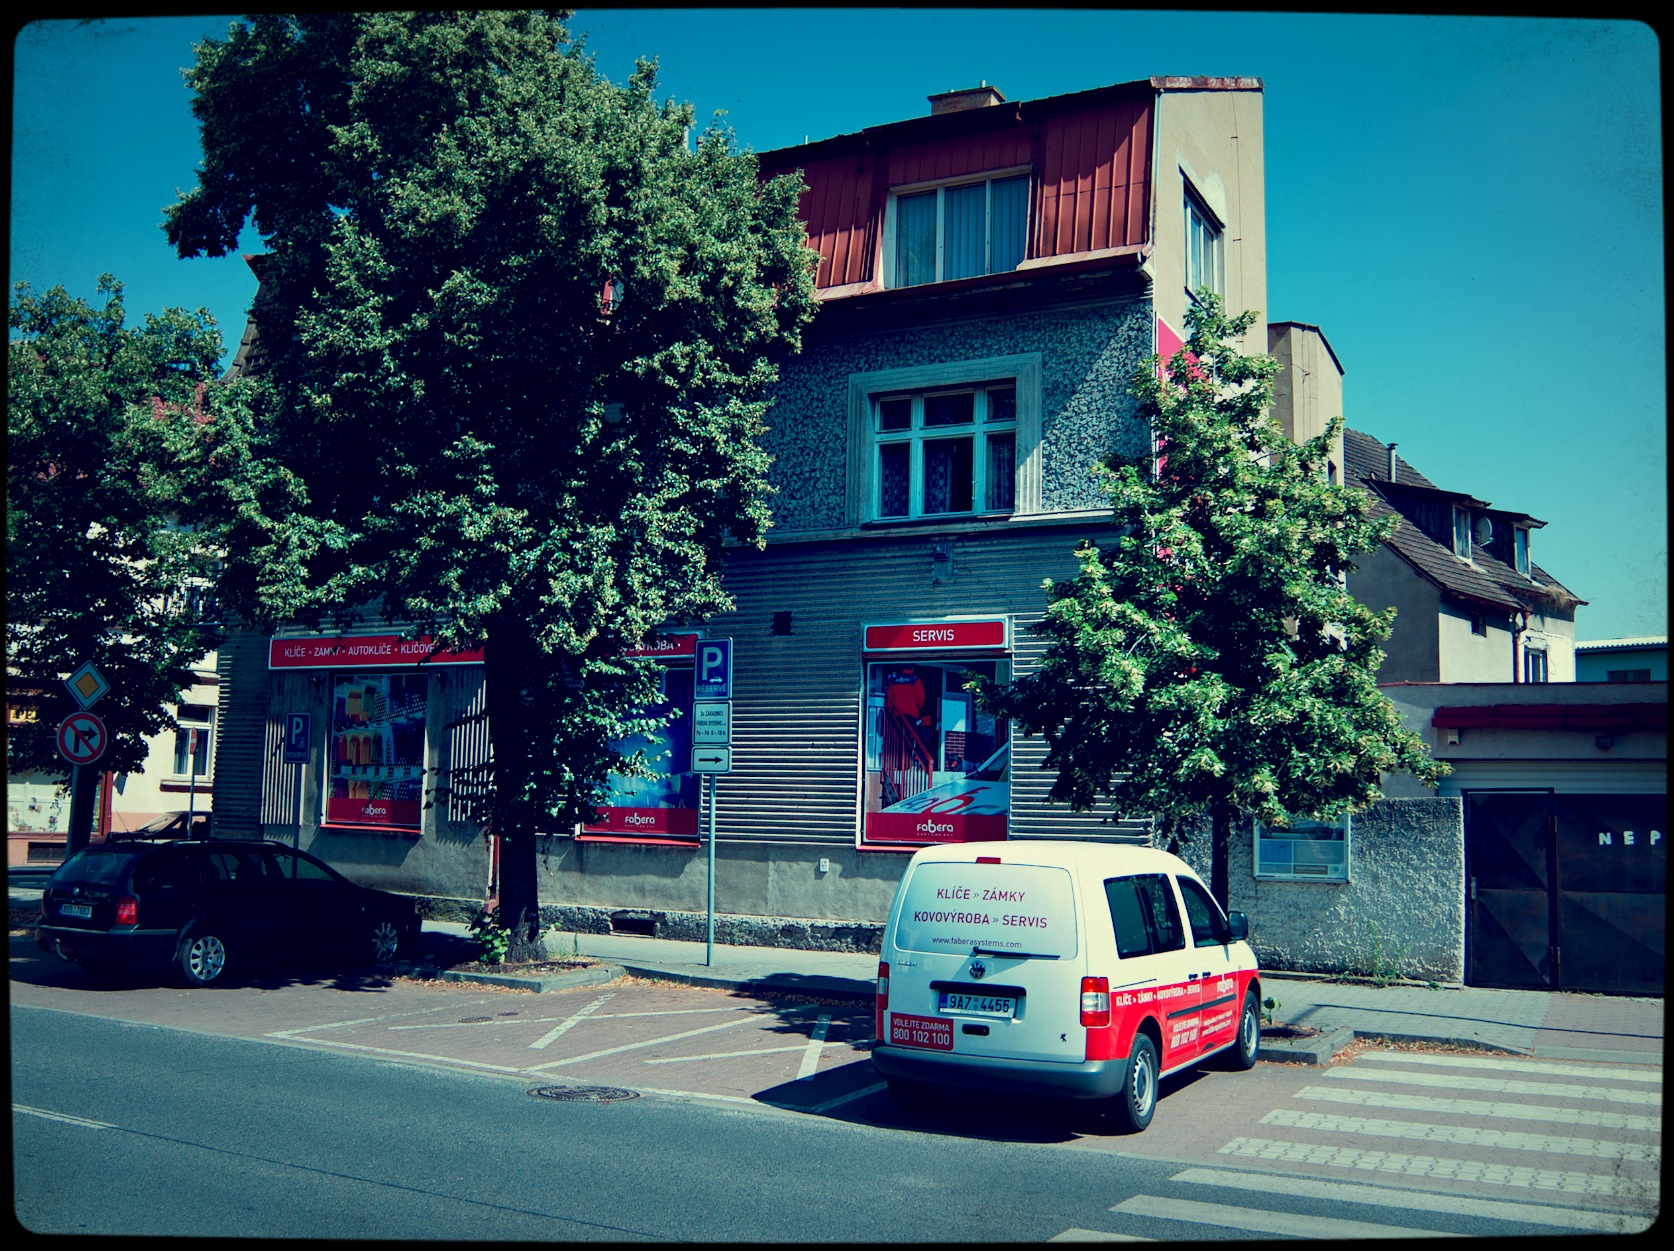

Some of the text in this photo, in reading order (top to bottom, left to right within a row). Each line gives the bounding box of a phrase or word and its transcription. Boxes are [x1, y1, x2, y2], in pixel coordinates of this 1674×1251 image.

[912, 629, 955, 642] SERVIS
[284, 646, 306, 657] KLÍČE
[347, 642, 392, 656] AUTOKLÍČE
[702, 646, 723, 681] P
[696, 682, 727, 693] RÉSERVÉ
[292, 717, 304, 745] P
[624, 812, 656, 826] fabera
[916, 819, 954, 834] fabera
[936, 885, 1026, 902] KLÍČE ZÁMKY
[913, 908, 1048, 929] KOVOVÝROBA SERVIS
[932, 936, 1022, 949] www.faberasystems.com
[949, 995, 1010, 1013] 9A7 4455
[893, 1017, 950, 1032] VOLEJTE ZDARMA
[893, 1027, 950, 1046] 800 102 100
